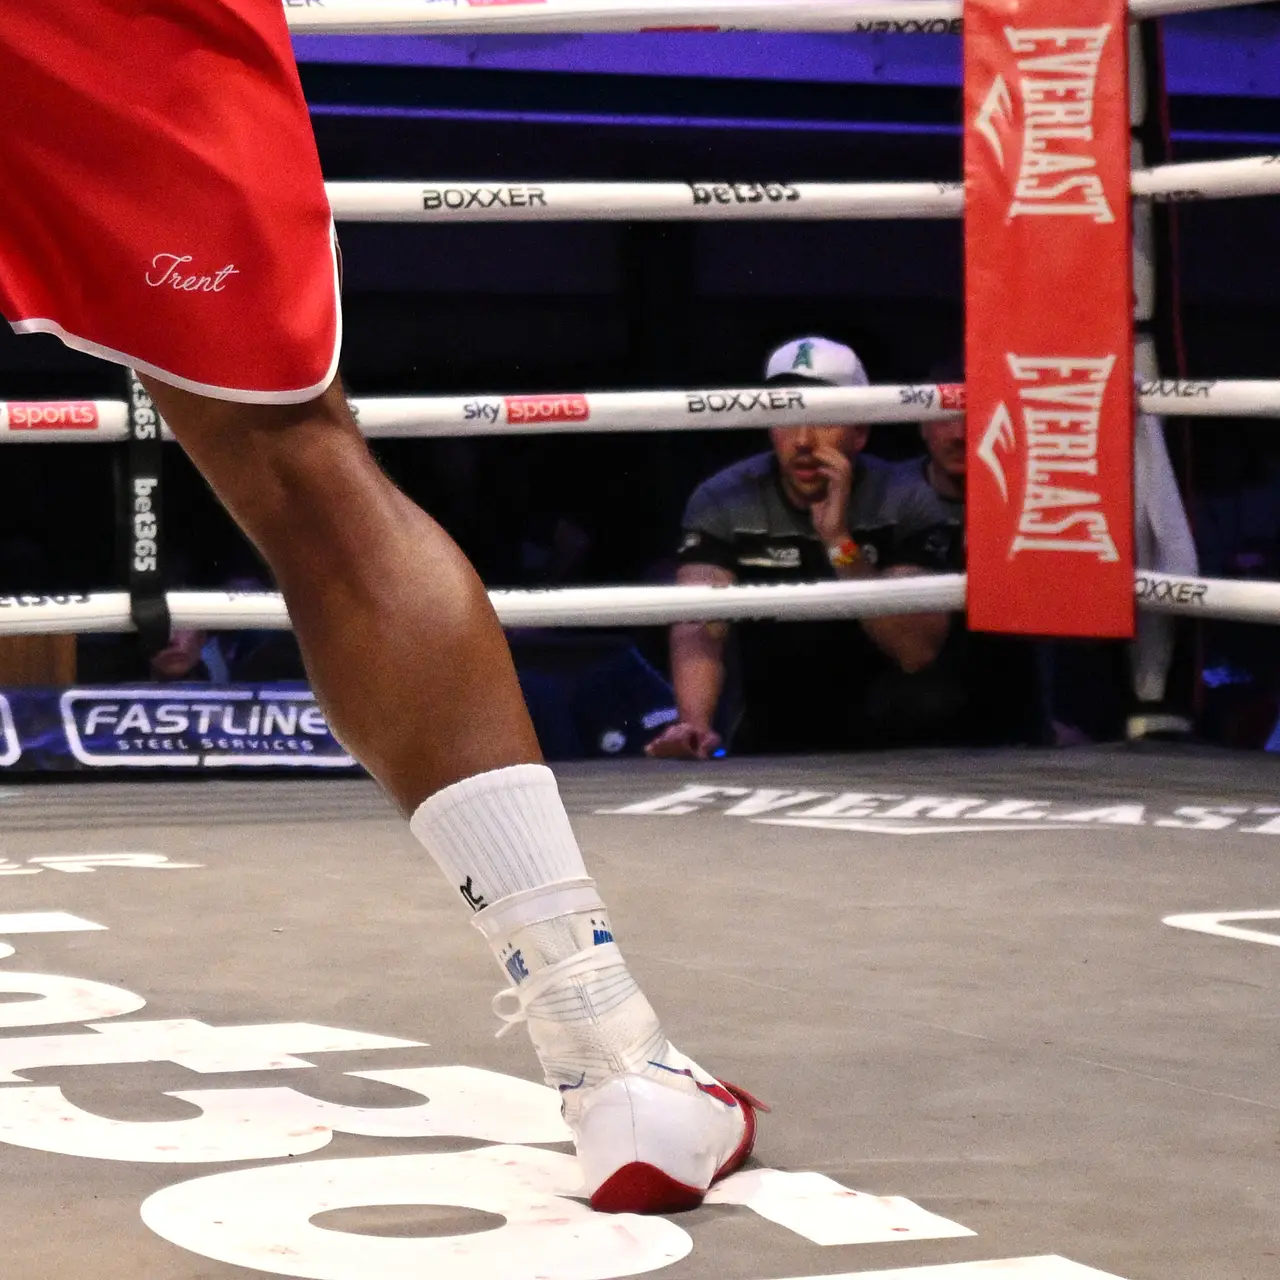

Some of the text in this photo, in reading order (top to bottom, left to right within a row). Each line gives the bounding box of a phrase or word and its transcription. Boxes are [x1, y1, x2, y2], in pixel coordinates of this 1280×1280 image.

[1000, 22, 1114, 225] EVERLAST
[422, 182, 801, 210] BOXXER bet365
[144, 251, 240, 293] Trent
[12, 403, 96, 429] sports
[462, 399, 501, 422] sky
[509, 395, 586, 418] sports
[686, 391, 806, 414] BOXXER
[899, 386, 936, 408] sky
[1004, 352, 1120, 564] EVERLAST
[134, 477, 159, 572] bet365
[84, 702, 328, 736] FASTLINE
[116, 736, 315, 753] STEEL SERVICES
